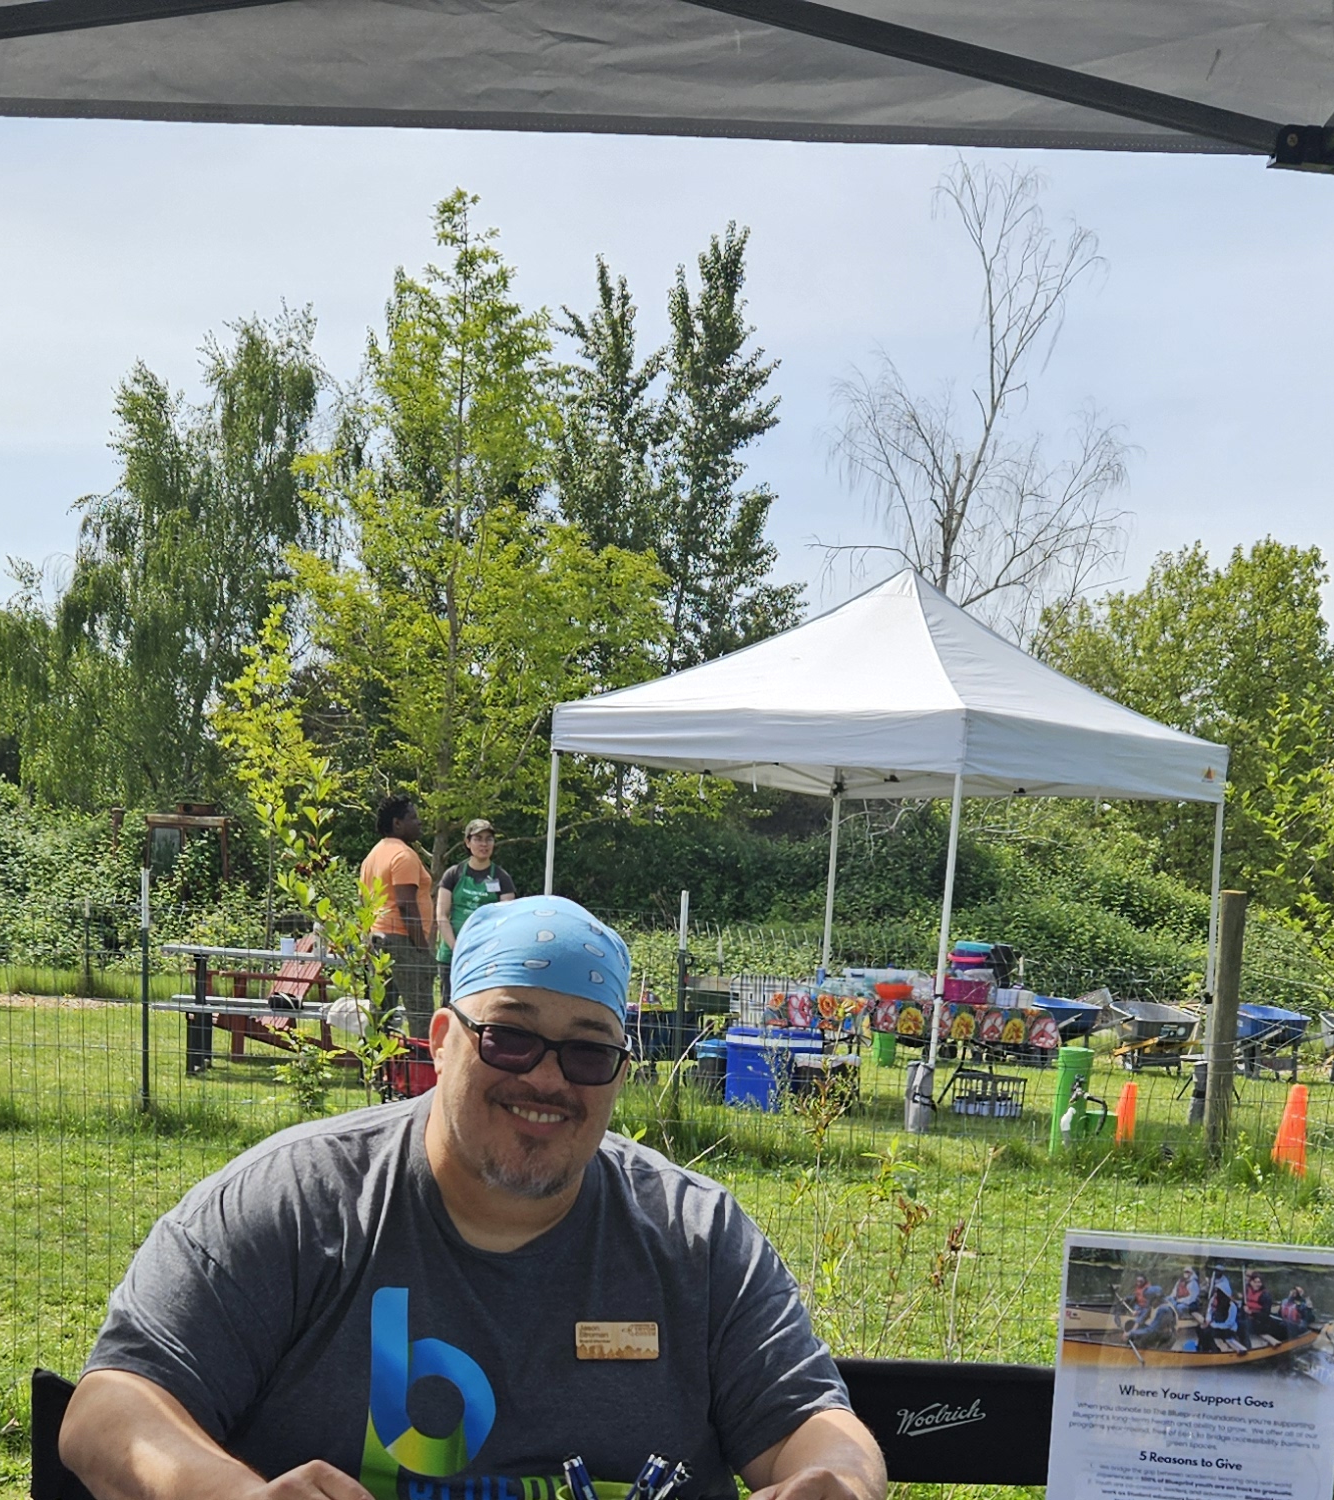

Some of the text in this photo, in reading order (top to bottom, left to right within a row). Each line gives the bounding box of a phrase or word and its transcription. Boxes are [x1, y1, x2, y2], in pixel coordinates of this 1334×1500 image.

[1119, 1384, 1274, 1409] Where Your Support Goes
[896, 1398, 986, 1436] Woolrich
[1139, 1451, 1242, 1471] 5 Reasons to Give
